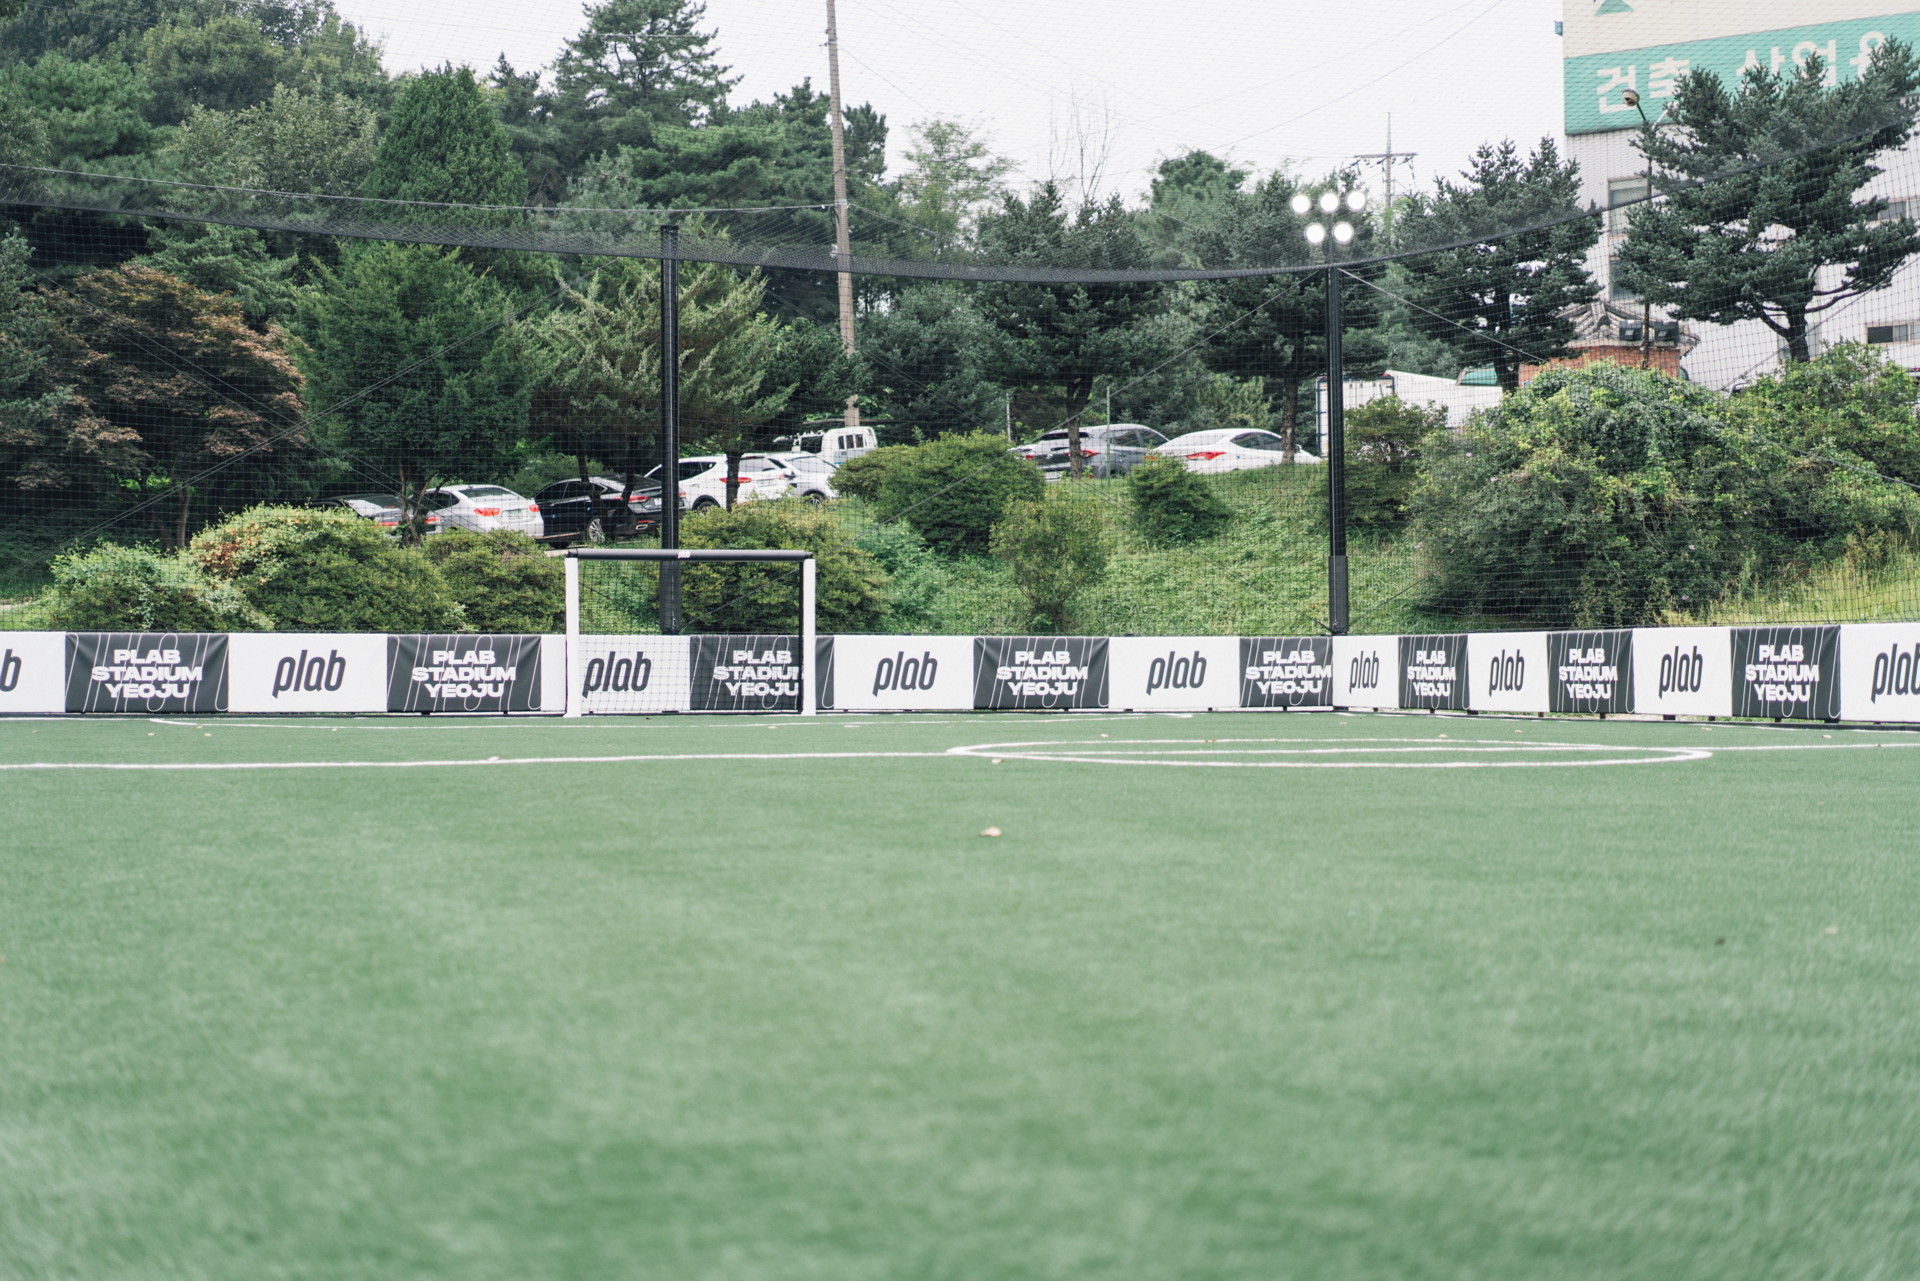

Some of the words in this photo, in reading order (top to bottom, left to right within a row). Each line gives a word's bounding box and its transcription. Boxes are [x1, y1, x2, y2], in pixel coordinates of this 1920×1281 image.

[1597, 57, 1690, 114] 건축
[113, 649, 181, 664] PLAB
[433, 650, 496, 665] PLAB
[733, 650, 792, 664] PLAB
[1015, 651, 1070, 665] PLAB
[1262, 650, 1315, 664] PLAB
[1415, 650, 1446, 665] PLAB
[1568, 648, 1605, 664] PLAB
[1758, 644, 1804, 662] PLAB
[92, 666, 203, 681] STADIUM
[272, 650, 346, 699] plab
[412, 667, 516, 681] STADIUM
[582, 651, 652, 699] plab
[872, 651, 938, 697] plab
[997, 666, 1088, 680] STADIUM
[1146, 651, 1207, 696] plab
[1245, 665, 1332, 679] STADIUM
[1349, 651, 1380, 694] plab
[1407, 666, 1456, 681] STADIUM
[1489, 649, 1525, 698] plab
[1558, 666, 1618, 681] STADIUM
[1659, 646, 1703, 700] plab
[1745, 664, 1819, 682] STADIUM
[105, 683, 190, 698] YEOJU
[424, 683, 504, 698] YEOJU
[725, 682, 799, 696] YEOJU
[1008, 682, 1078, 696] YEOJU
[1256, 680, 1322, 694] YEOJU
[1413, 682, 1451, 697] YEOJU
[1565, 683, 1611, 699] YEOJU
[1754, 684, 1810, 702] YEOJU
